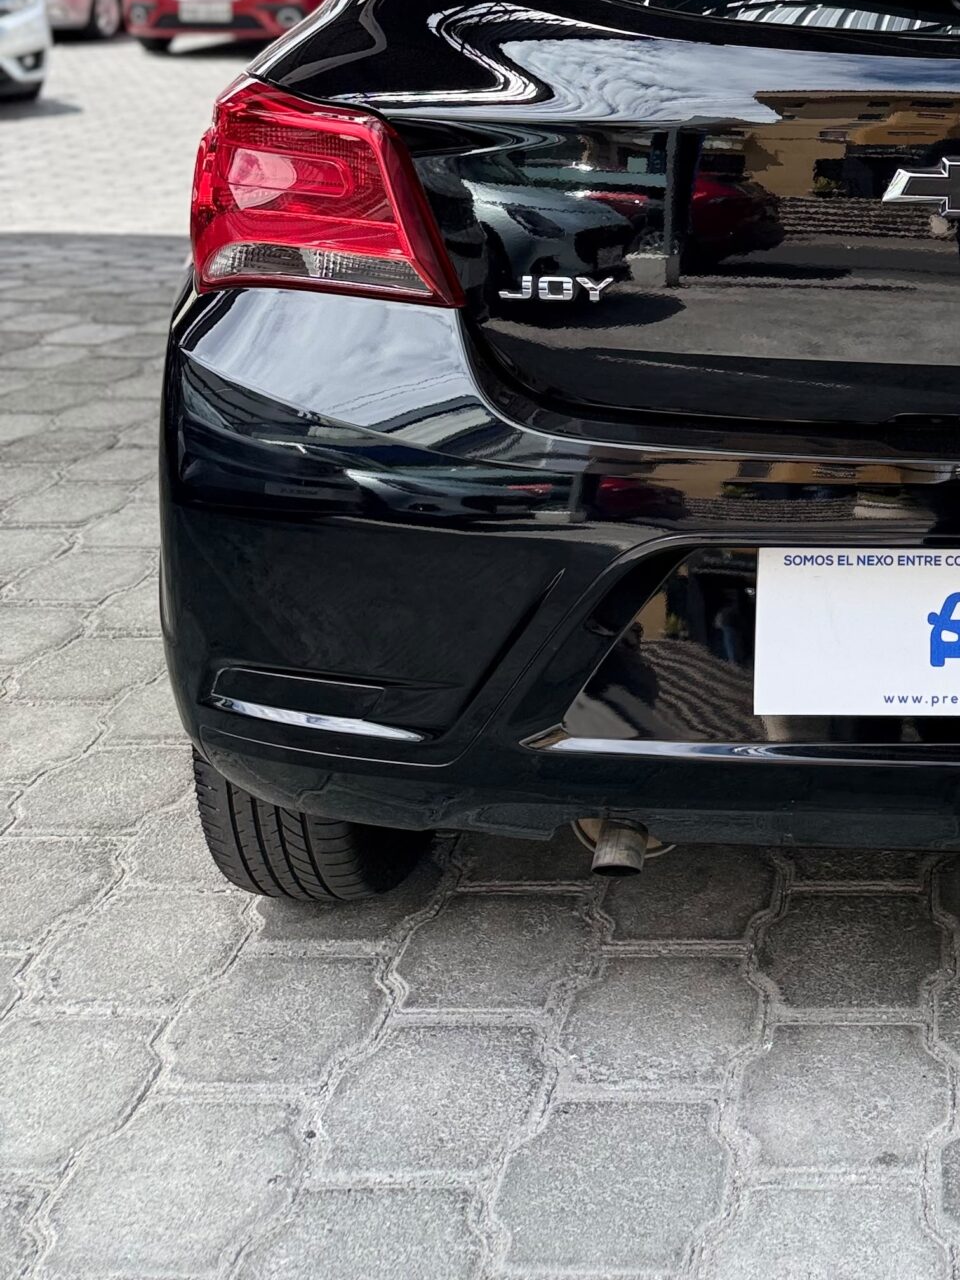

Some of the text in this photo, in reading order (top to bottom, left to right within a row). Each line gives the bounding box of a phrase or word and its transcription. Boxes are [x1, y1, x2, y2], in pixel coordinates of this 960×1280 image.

[498, 275, 614, 302] JOY
[783, 554, 834, 567] SOMOS
[837, 554, 853, 566] EL
[856, 554, 894, 567] NEXO
[897, 554, 942, 567] ENTRE
